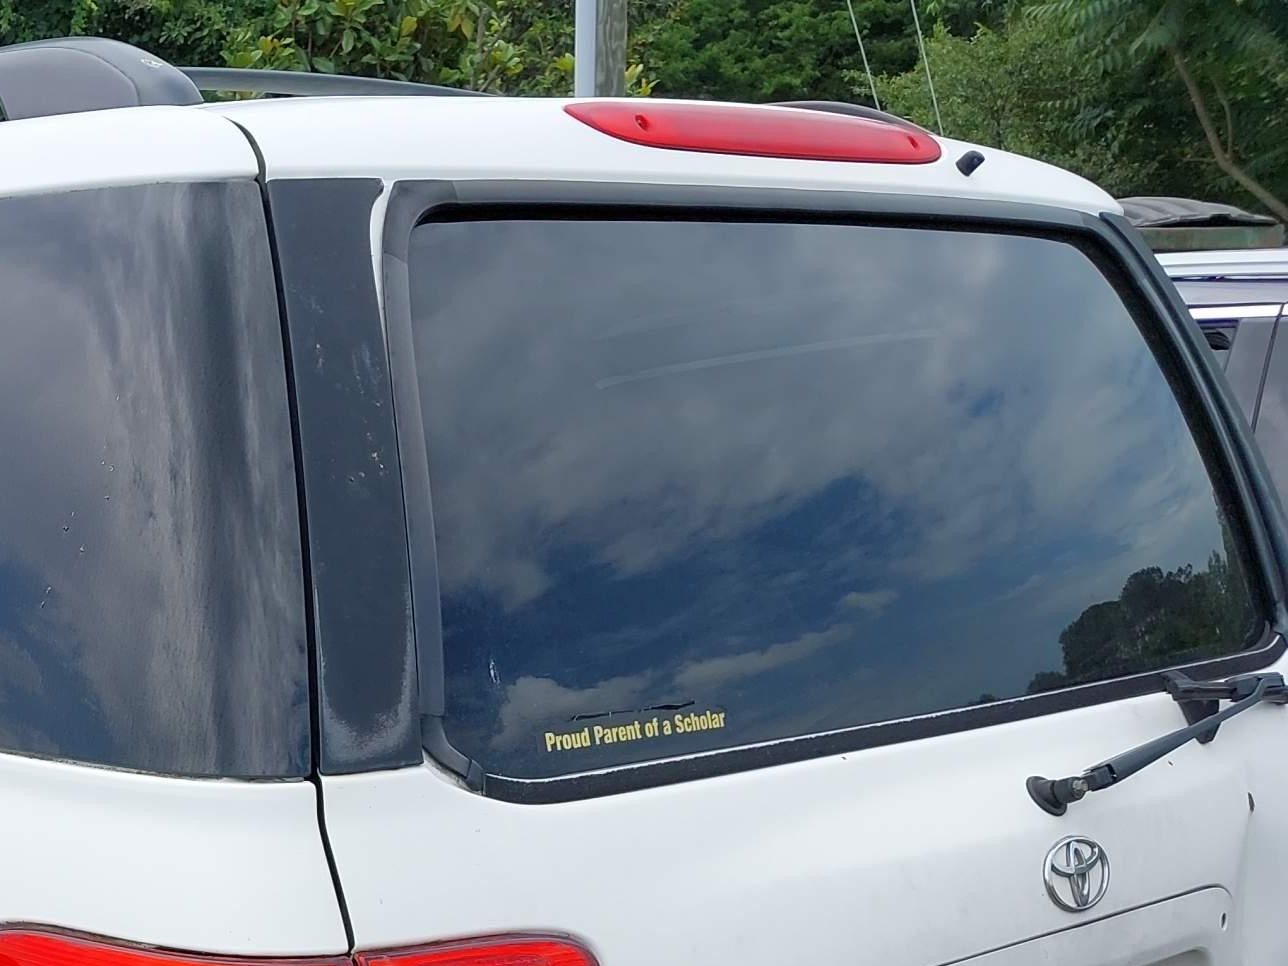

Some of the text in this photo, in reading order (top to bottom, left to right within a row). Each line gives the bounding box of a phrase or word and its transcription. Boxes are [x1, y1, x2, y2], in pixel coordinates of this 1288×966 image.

[544, 710, 726, 752] Proud Parent of a Scholar
